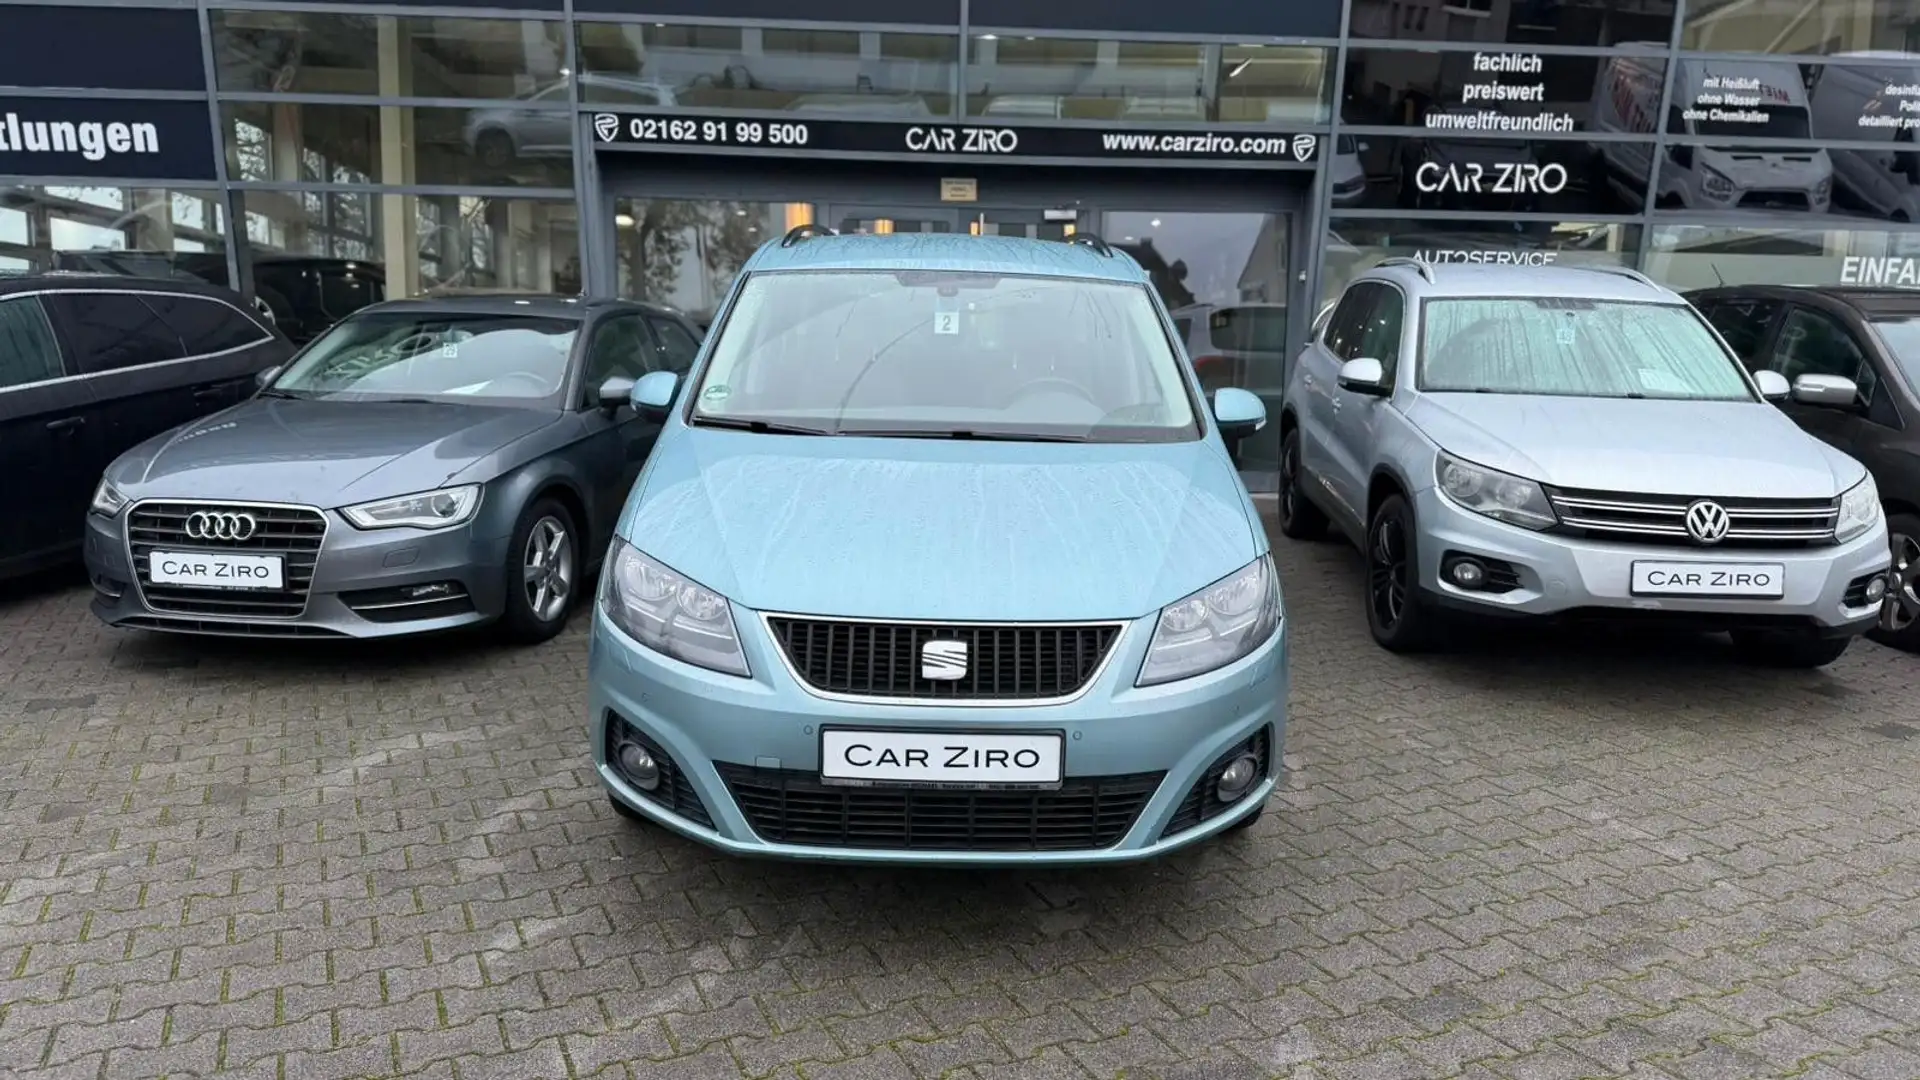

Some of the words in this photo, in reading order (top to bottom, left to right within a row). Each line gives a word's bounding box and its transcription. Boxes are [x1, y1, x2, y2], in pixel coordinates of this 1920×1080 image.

[1473, 52, 1543, 73] fachlich
[1462, 81, 1545, 103] preiswert
[1703, 77, 1720, 88] mit
[1697, 92, 1722, 104] ohne
[1724, 93, 1761, 106] Wasser
[1425, 110, 1574, 132] umweltfreundlich
[1682, 108, 1708, 120] ohne
[1709, 108, 1770, 123] Chemikalien
[630, 118, 697, 141] 02162
[703, 121, 727, 142] 91
[735, 122, 763, 143] 99
[768, 124, 808, 145] 500
[905, 126, 956, 151] CAR
[961, 128, 1018, 152] ZIRO
[1102, 132, 1287, 154] www.carziro.com
[1415, 161, 1484, 193] CAR
[1491, 163, 1568, 194] ZIRO
[1840, 256, 1920, 285] EINFA
[942, 314, 952, 331] 2
